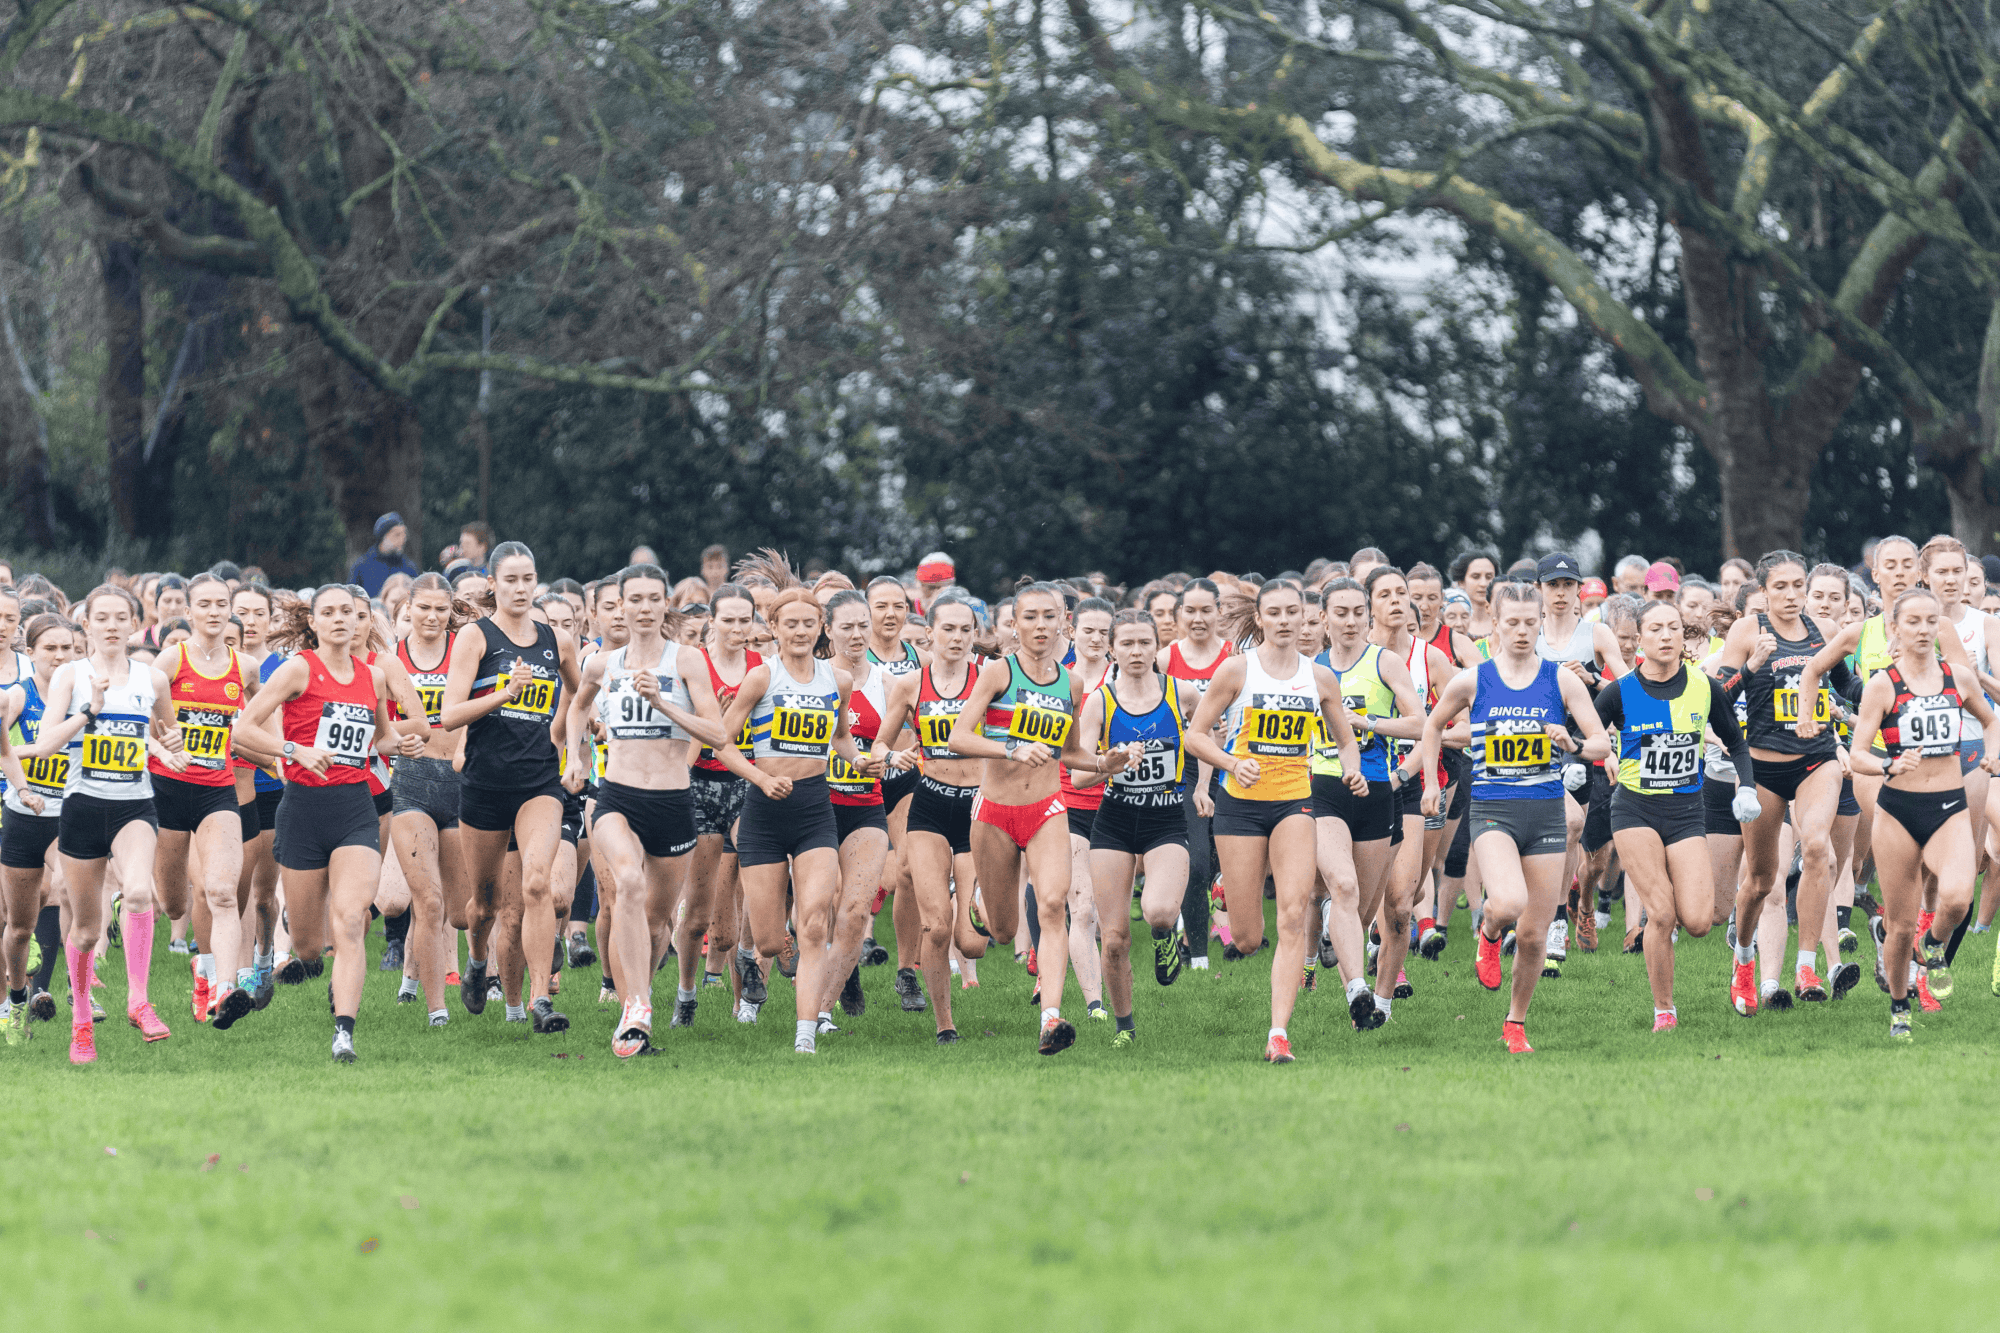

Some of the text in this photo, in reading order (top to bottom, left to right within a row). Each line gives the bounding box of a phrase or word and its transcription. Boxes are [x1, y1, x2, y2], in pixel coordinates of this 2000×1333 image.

[1488, 706, 1549, 718] BINGLEY
[1781, 692, 1825, 717] 106
[779, 711, 828, 740] 1058
[929, 719, 958, 743] 10
[1017, 708, 1066, 741] 1003
[1257, 713, 1306, 740] 1034
[1911, 713, 1950, 742] 943
[327, 723, 365, 753] 999
[1493, 738, 1543, 762] 1024
[90, 739, 138, 767] 1042
[1645, 749, 1696, 775] 4429
[27, 756, 71, 784] 1012
[921, 777, 980, 798] NIKE PR
[1152, 793, 1185, 807] NIKE
